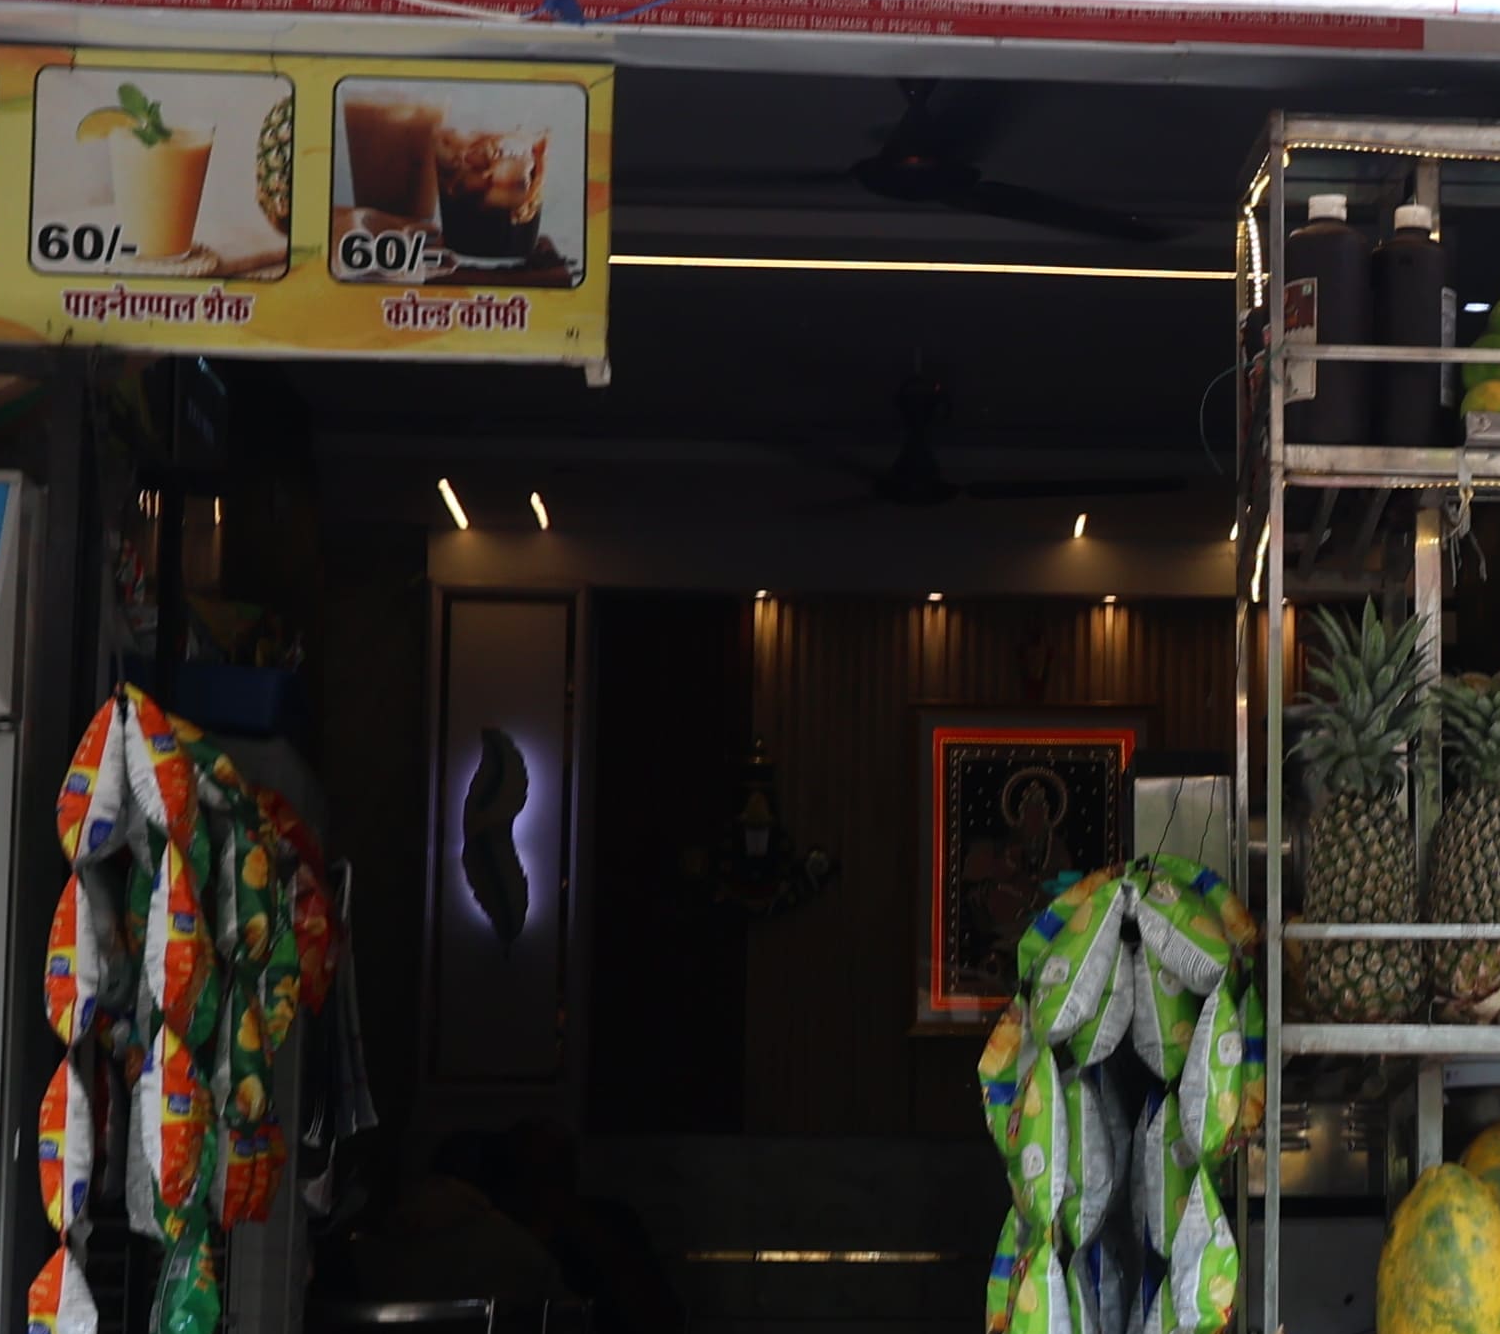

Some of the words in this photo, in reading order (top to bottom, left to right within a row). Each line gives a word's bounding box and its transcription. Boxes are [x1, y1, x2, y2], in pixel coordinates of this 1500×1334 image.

[36, 222, 138, 266] 60/-
[339, 230, 444, 274] 60/-
[202, 287, 254, 325] शेक
